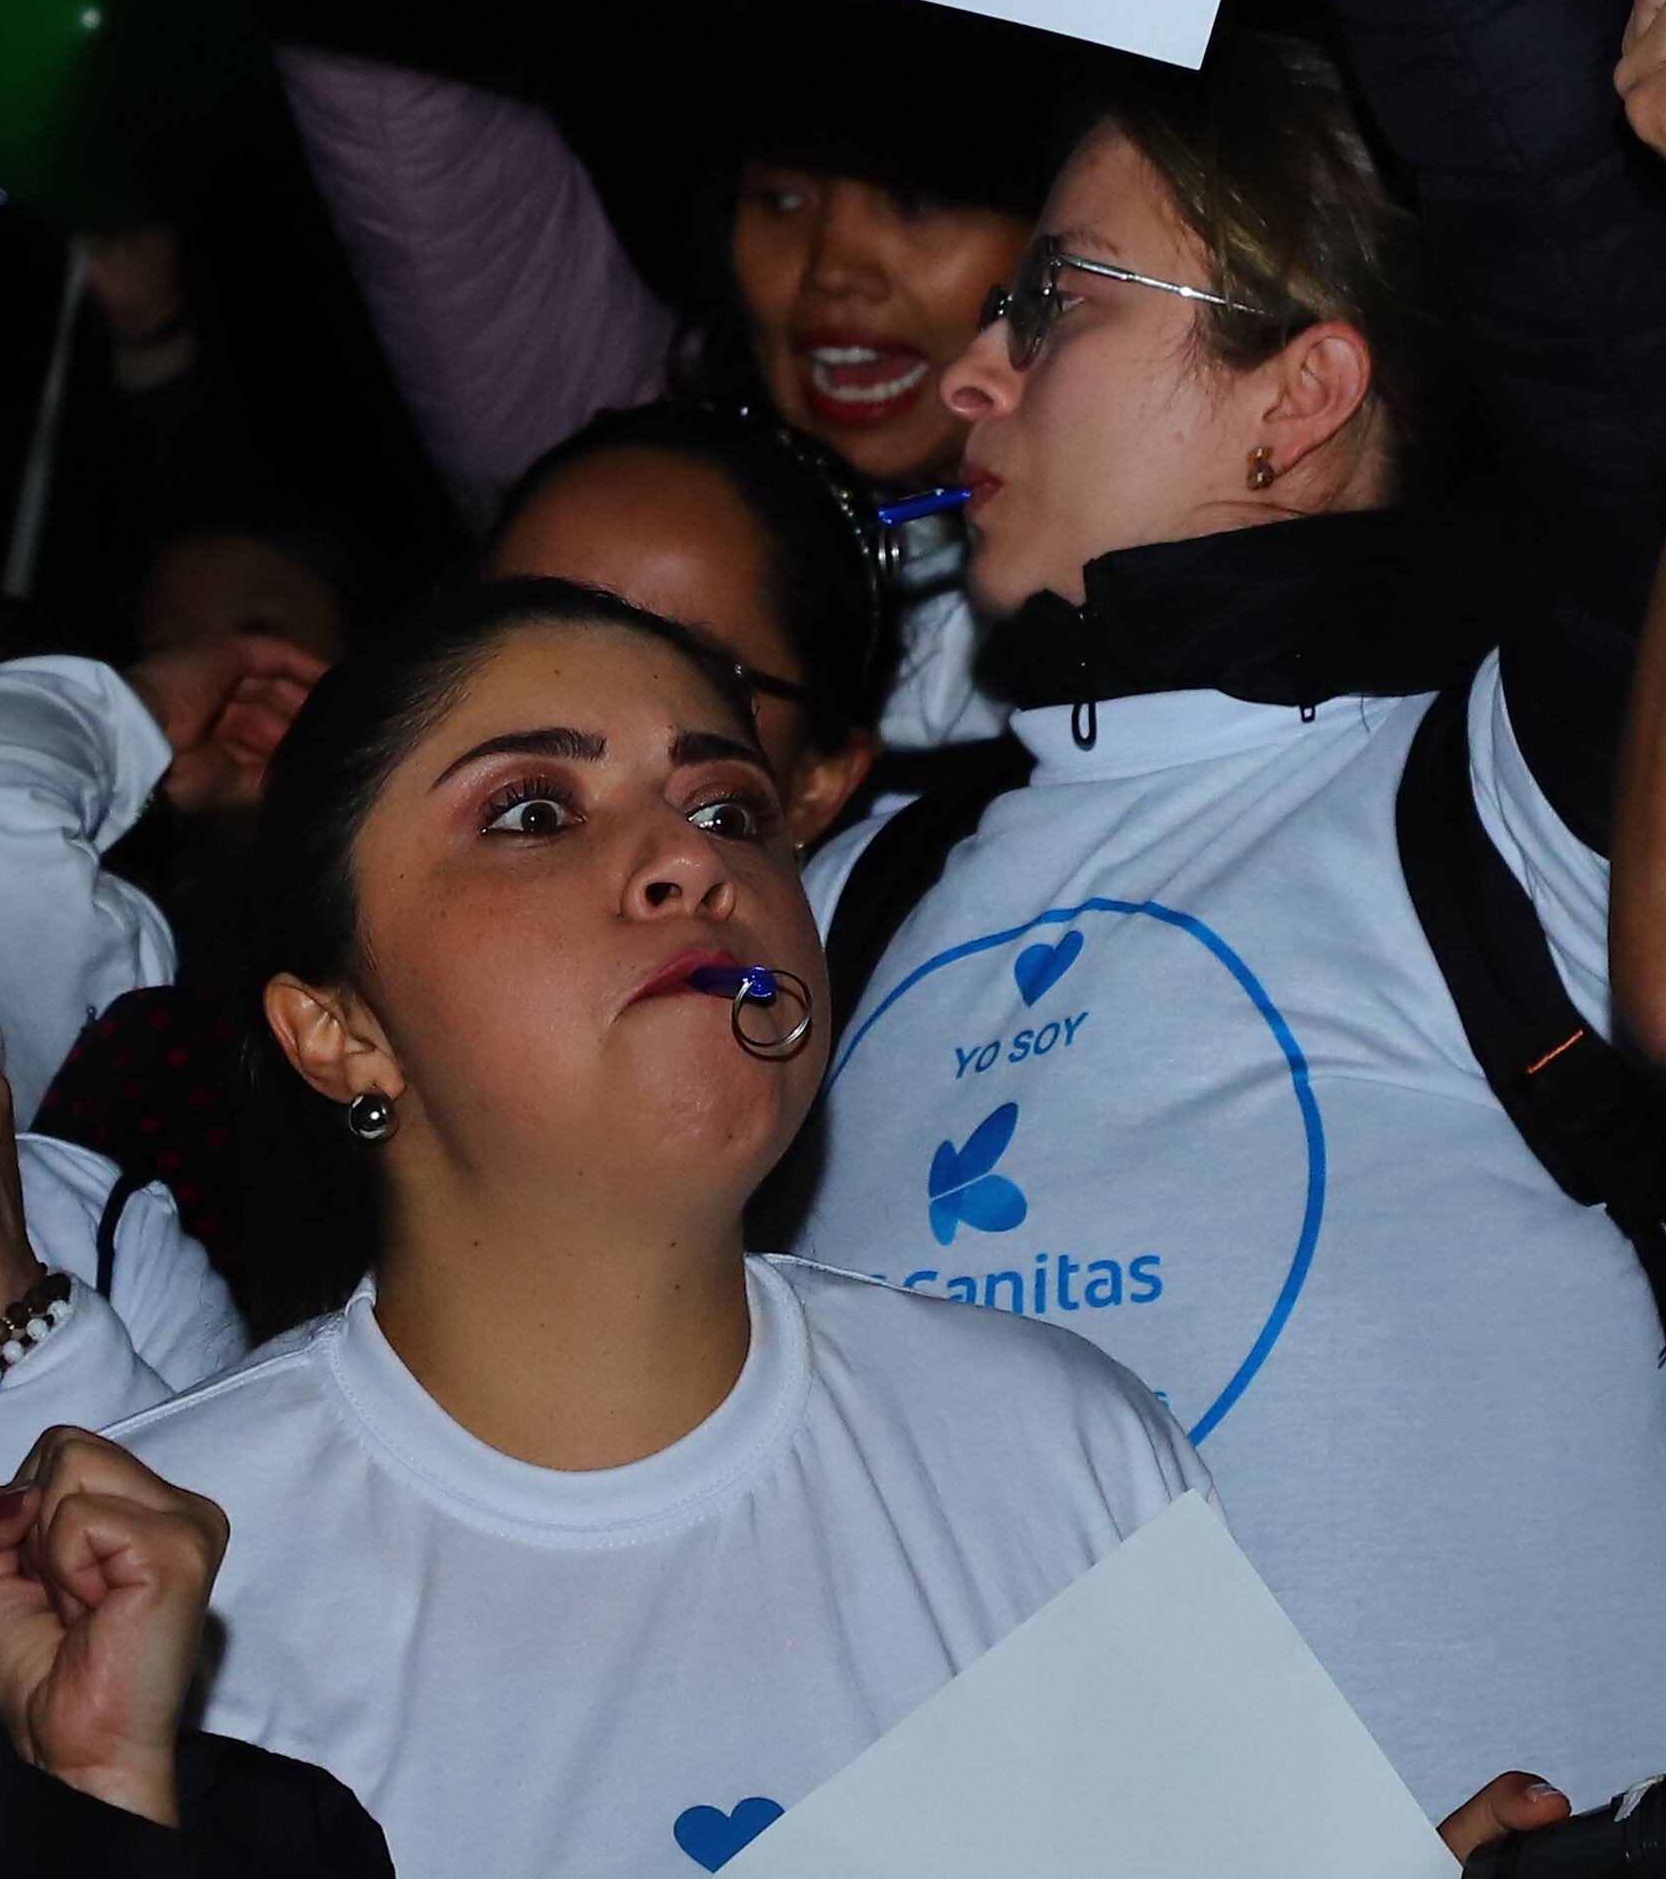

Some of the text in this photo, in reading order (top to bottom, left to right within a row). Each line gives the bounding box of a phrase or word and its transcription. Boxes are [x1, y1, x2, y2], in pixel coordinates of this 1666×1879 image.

[954, 1011, 1089, 1080] YO SOY
[902, 1253, 1163, 1315] anitas
